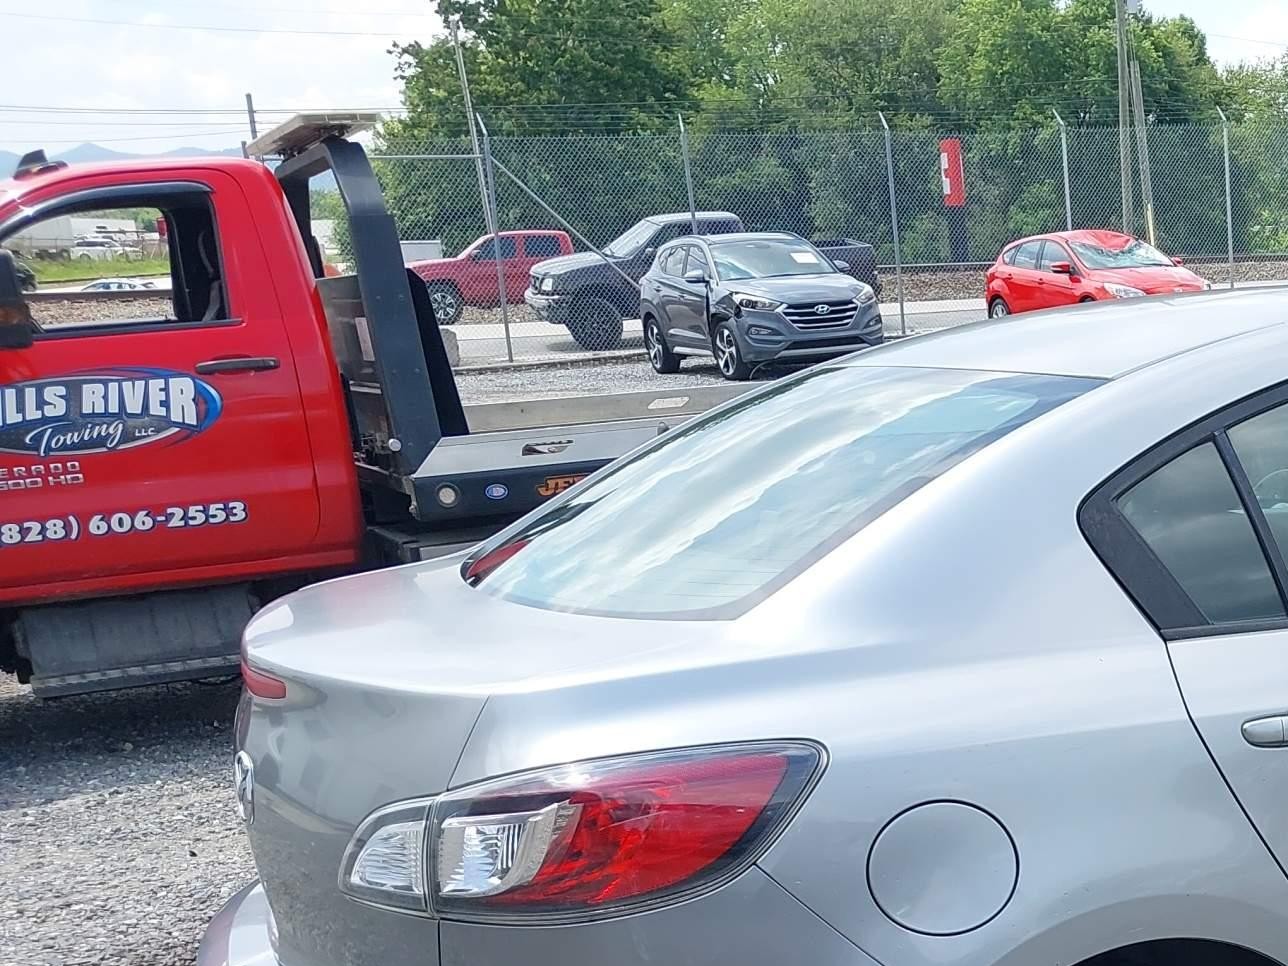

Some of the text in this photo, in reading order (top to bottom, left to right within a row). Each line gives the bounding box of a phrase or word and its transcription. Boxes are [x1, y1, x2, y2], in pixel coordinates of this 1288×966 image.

[82, 377, 198, 426] RIVER
[25, 420, 157, 456] Towing LLC
[48, 473, 84, 486] HD
[88, 501, 247, 535] 606-2553
